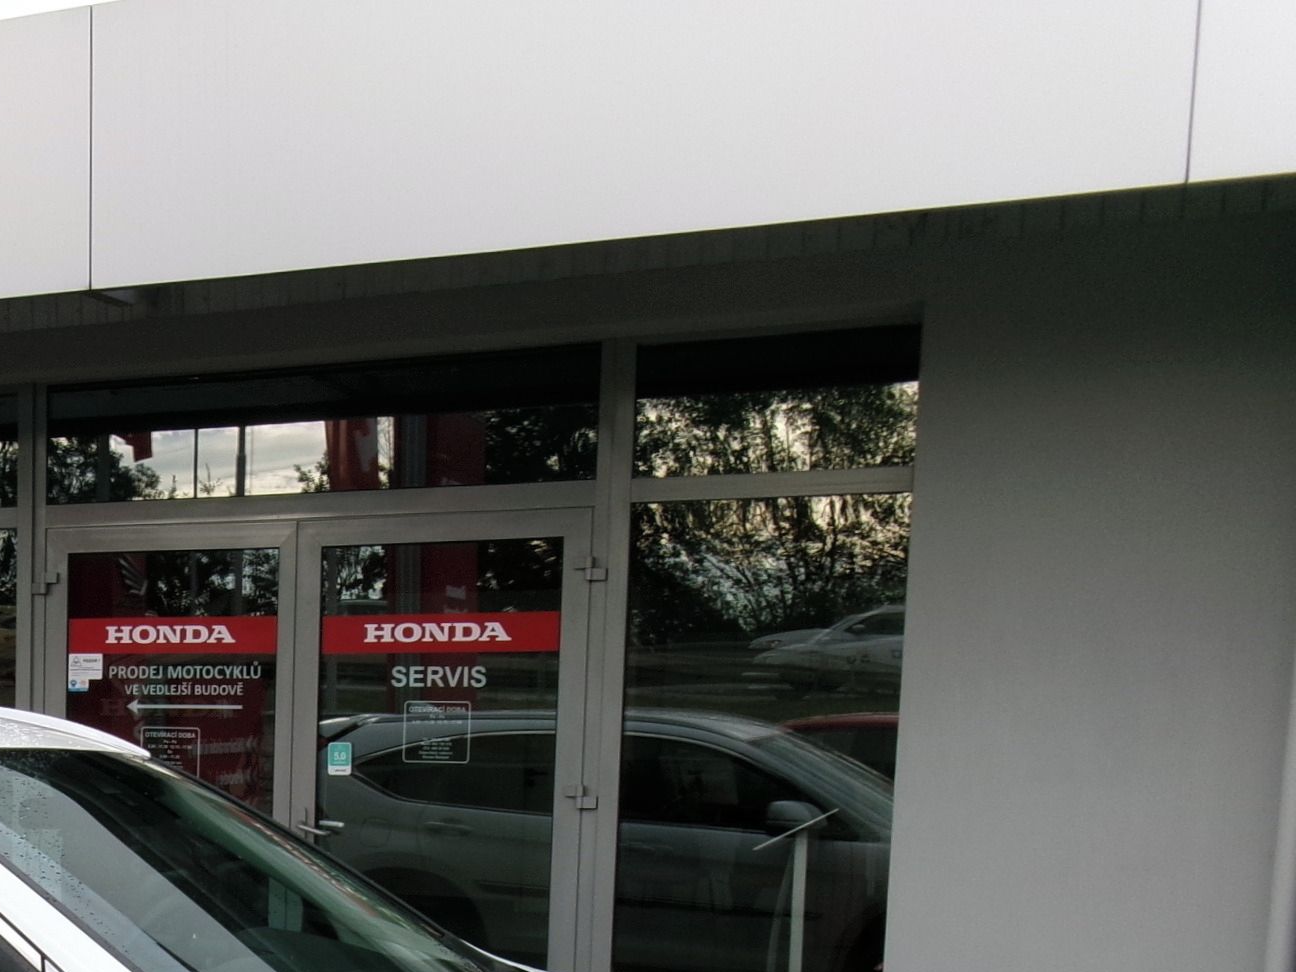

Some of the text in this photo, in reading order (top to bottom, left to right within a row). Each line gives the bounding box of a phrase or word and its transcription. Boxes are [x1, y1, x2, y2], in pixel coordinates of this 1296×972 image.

[105, 625, 236, 644] HONDA
[364, 622, 512, 643] HONDA
[108, 665, 164, 680] PRODEJ
[167, 661, 262, 680] MOTOCYKLŮ
[391, 666, 487, 688] SERVIS
[125, 682, 244, 697] VE VEDLEJŠÍ BUDOVĚ
[179, 731, 196, 739] DOBA
